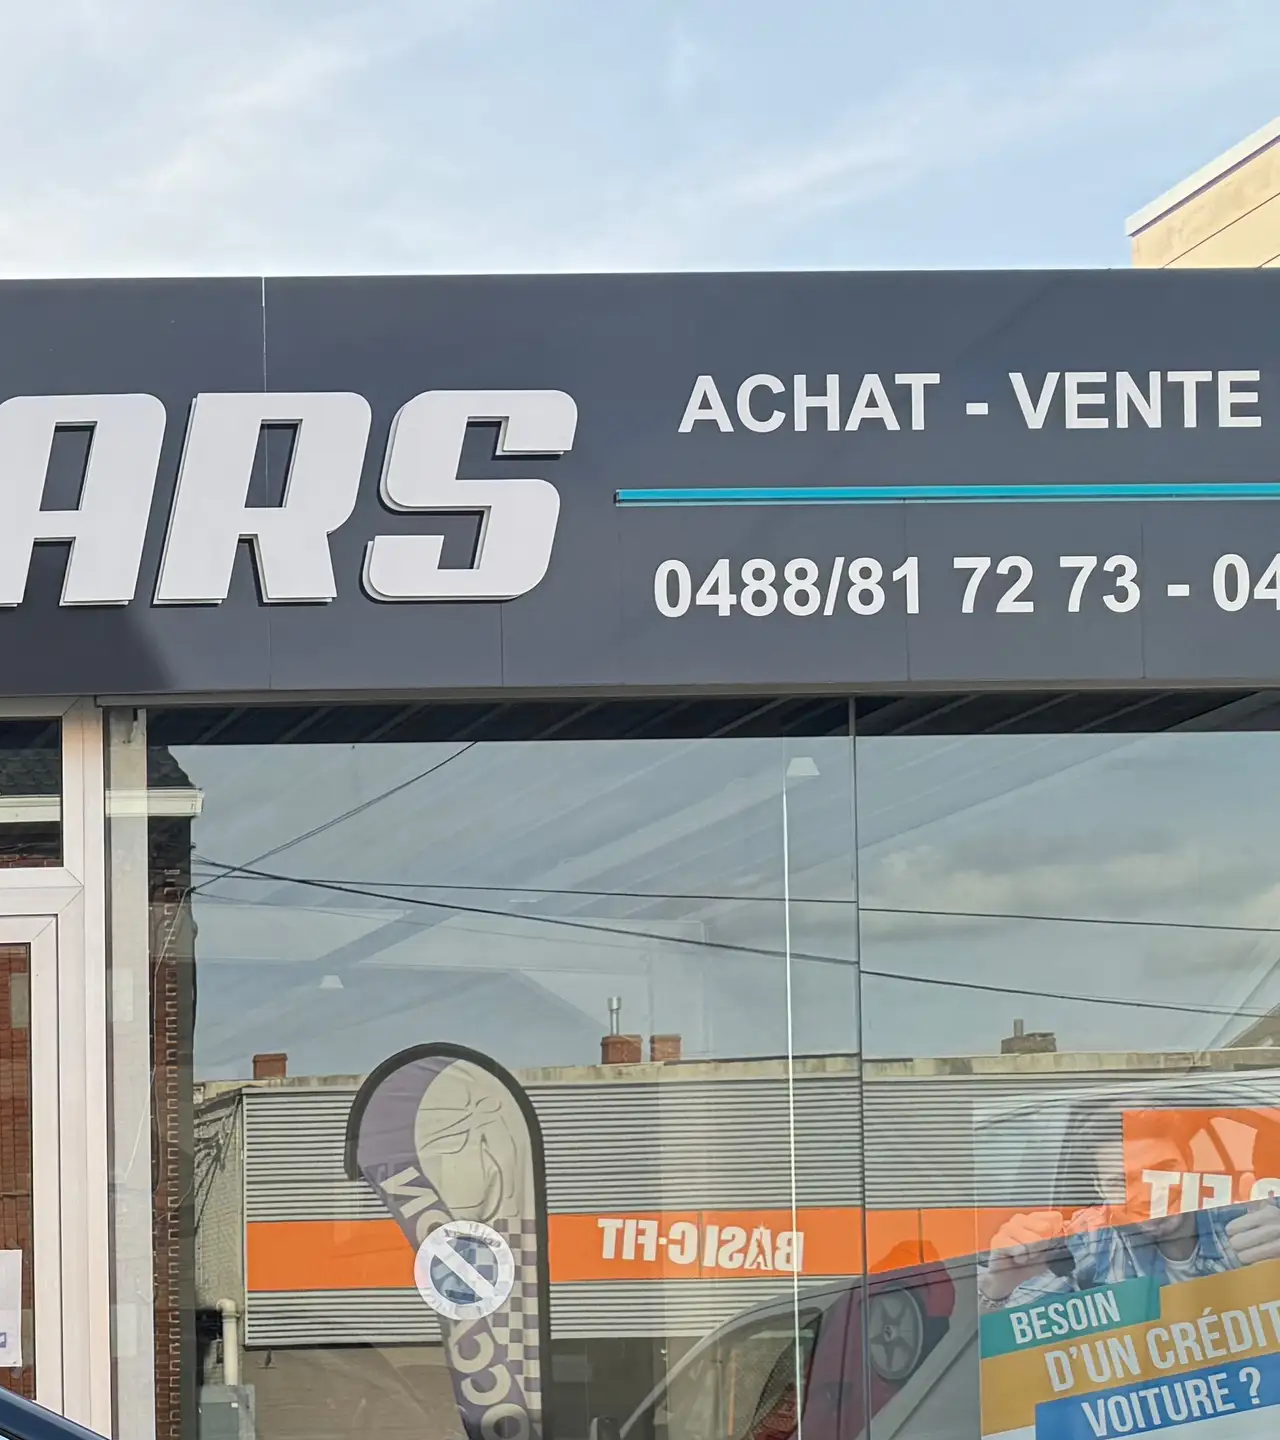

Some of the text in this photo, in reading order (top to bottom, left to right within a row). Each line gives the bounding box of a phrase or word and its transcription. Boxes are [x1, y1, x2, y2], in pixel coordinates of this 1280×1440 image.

[678, 373, 940, 432] ACHAT
[1009, 369, 1262, 430] VENTE
[653, 556, 920, 618] 0488/81
[953, 556, 1035, 614] 72
[1059, 554, 1141, 613] 73
[1213, 553, 1280, 611] 04
[1009, 1290, 1121, 1344] BESOIN
[1044, 1300, 1280, 1392] D'UN CRÉDIT
[1081, 1371, 1236, 1438] VOITURE
